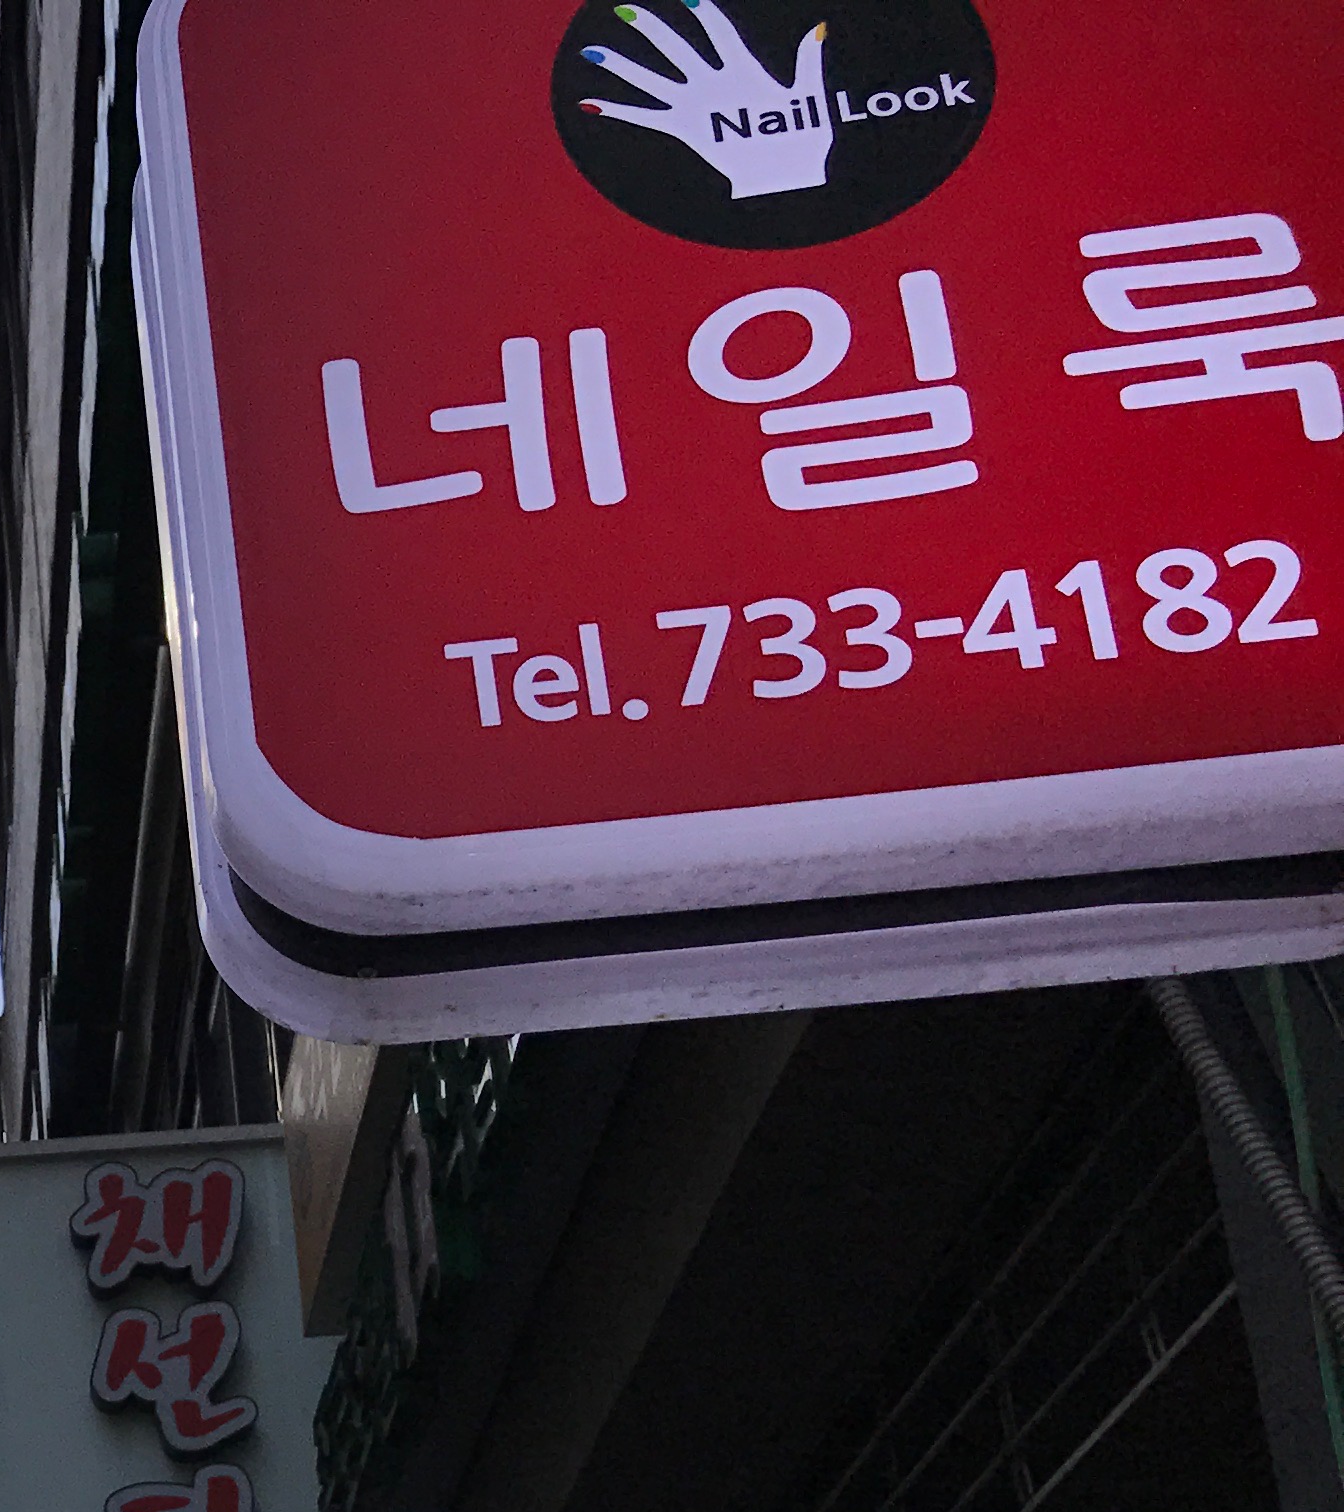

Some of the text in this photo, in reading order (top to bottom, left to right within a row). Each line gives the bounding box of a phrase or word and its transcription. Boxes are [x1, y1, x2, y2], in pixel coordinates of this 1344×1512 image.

[711, 73, 976, 143] Nail Look
[322, 212, 1344, 515] 네일룩
